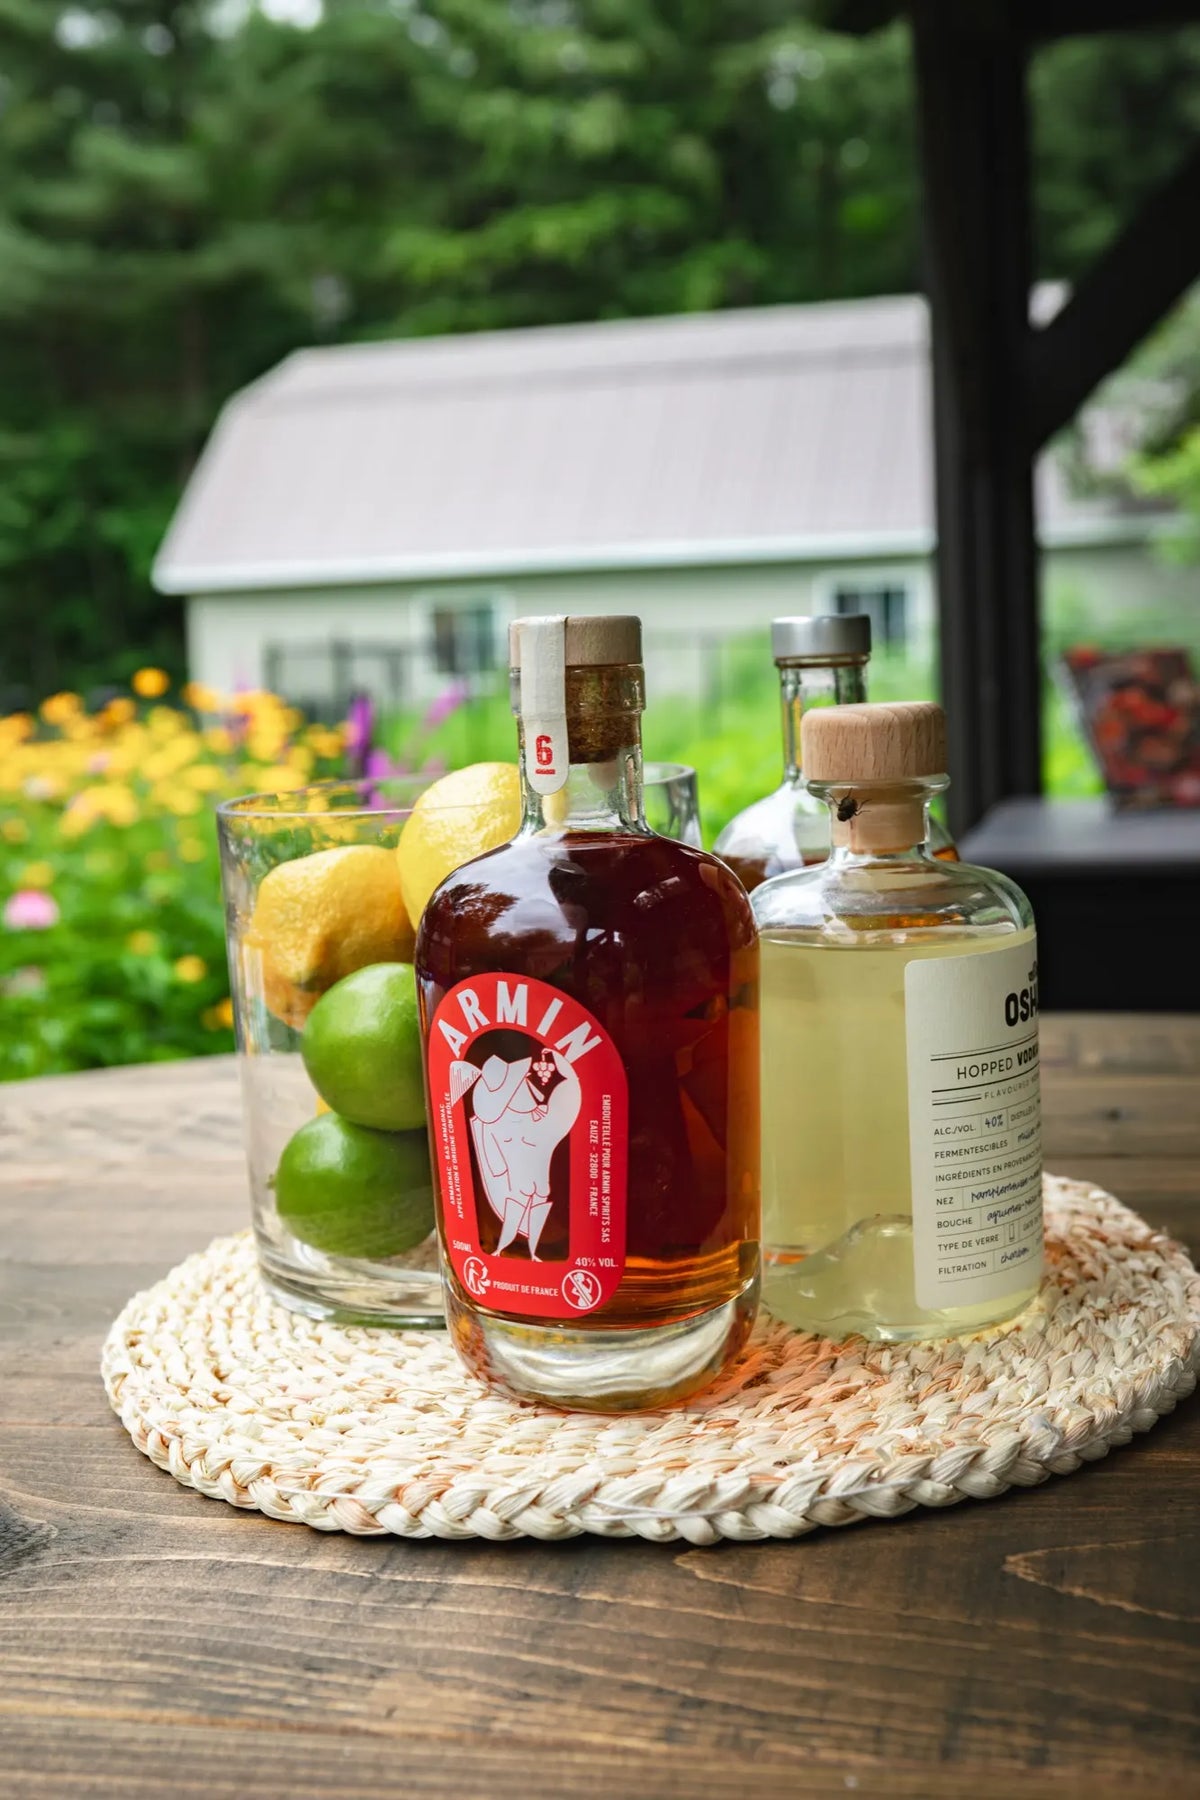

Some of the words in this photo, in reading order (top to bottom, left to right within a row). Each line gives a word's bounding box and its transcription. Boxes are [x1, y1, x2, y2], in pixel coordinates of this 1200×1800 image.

[535, 735, 553, 766] 6
[437, 980, 602, 1064] ARMIN
[957, 1057, 1013, 1080] HOPPED
[984, 1079, 1030, 1099] FLAVOURED
[602, 1094, 612, 1147] EMBOUTEILLÉ
[934, 1124, 976, 1136] ALC./VOL.
[985, 1114, 1004, 1128] 40%
[589, 1120, 598, 1144] EAUZE
[602, 1147, 611, 1168] POUR
[934, 1139, 1008, 1159] FERMENTESCIBLES
[589, 1152, 598, 1179] 32800
[936, 1166, 991, 1182] INGRÉDIENTS
[993, 1163, 1002, 1174] EN
[445, 1168, 455, 1206] ARMAGNAC
[602, 1169, 611, 1194] ARMIN
[454, 1174, 464, 1219] APPELLATION
[589, 1186, 598, 1217] FRANCE
[936, 1197, 954, 1206] NEZ
[601, 1196, 611, 1226] SPIRITS
[937, 1217, 973, 1229] BOUCHE
[601, 1227, 611, 1243] SAS
[938, 1241, 959, 1251] TYPE
[962, 1240, 973, 1248] DE
[976, 1234, 999, 1246] VERRE
[452, 1240, 473, 1253] 500ML
[575, 1257, 596, 1267] 40%
[598, 1257, 618, 1267] VOL.
[939, 1261, 987, 1275] FILTRATION
[493, 1281, 520, 1293] PRODUIT
[521, 1285, 530, 1294] DE
[531, 1285, 559, 1297] FRANCE
